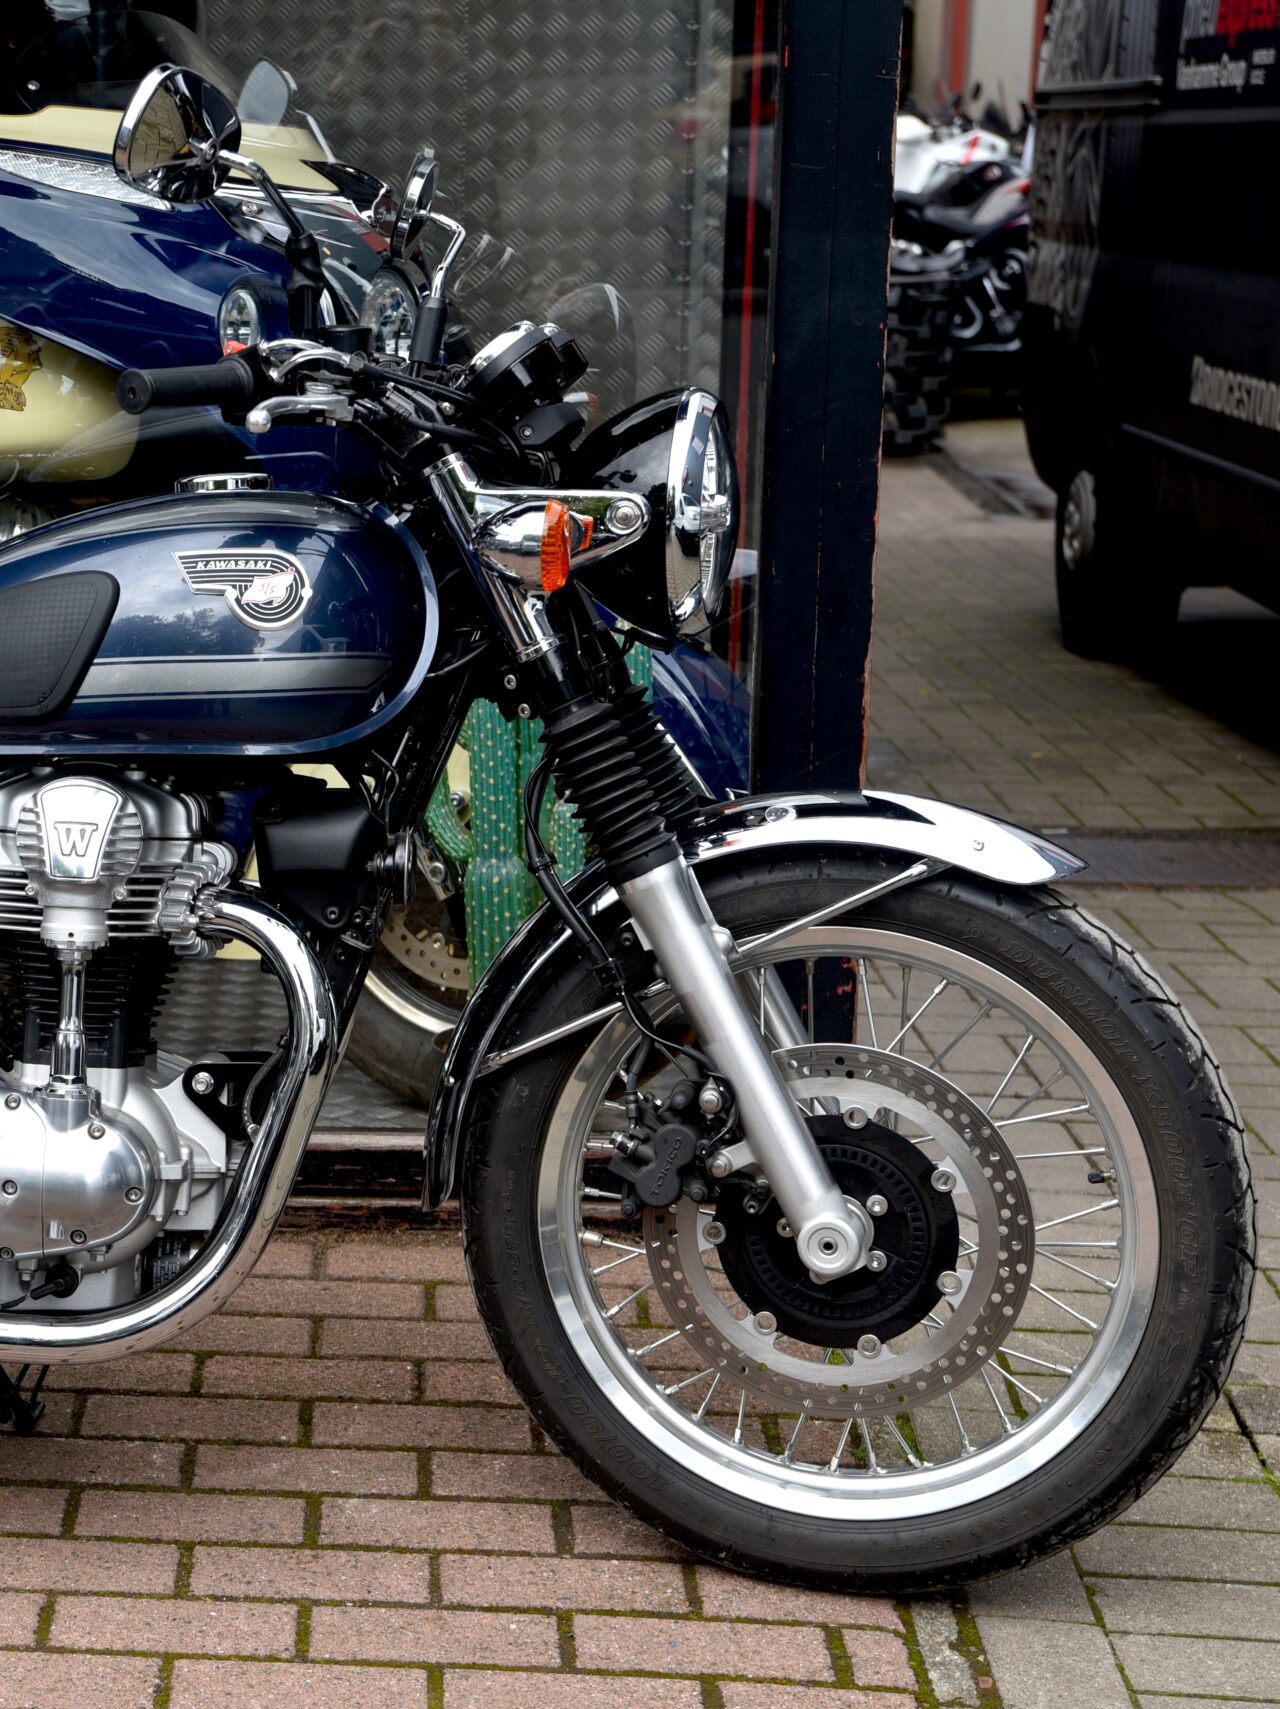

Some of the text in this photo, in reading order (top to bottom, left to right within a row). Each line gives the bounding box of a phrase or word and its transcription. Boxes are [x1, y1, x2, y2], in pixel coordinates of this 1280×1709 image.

[196, 560, 272, 570] KAWASAKI
[53, 820, 99, 857] W
[1000, 940, 1144, 1065] DUNLOP
[649, 1135, 683, 1197] TOKICO
